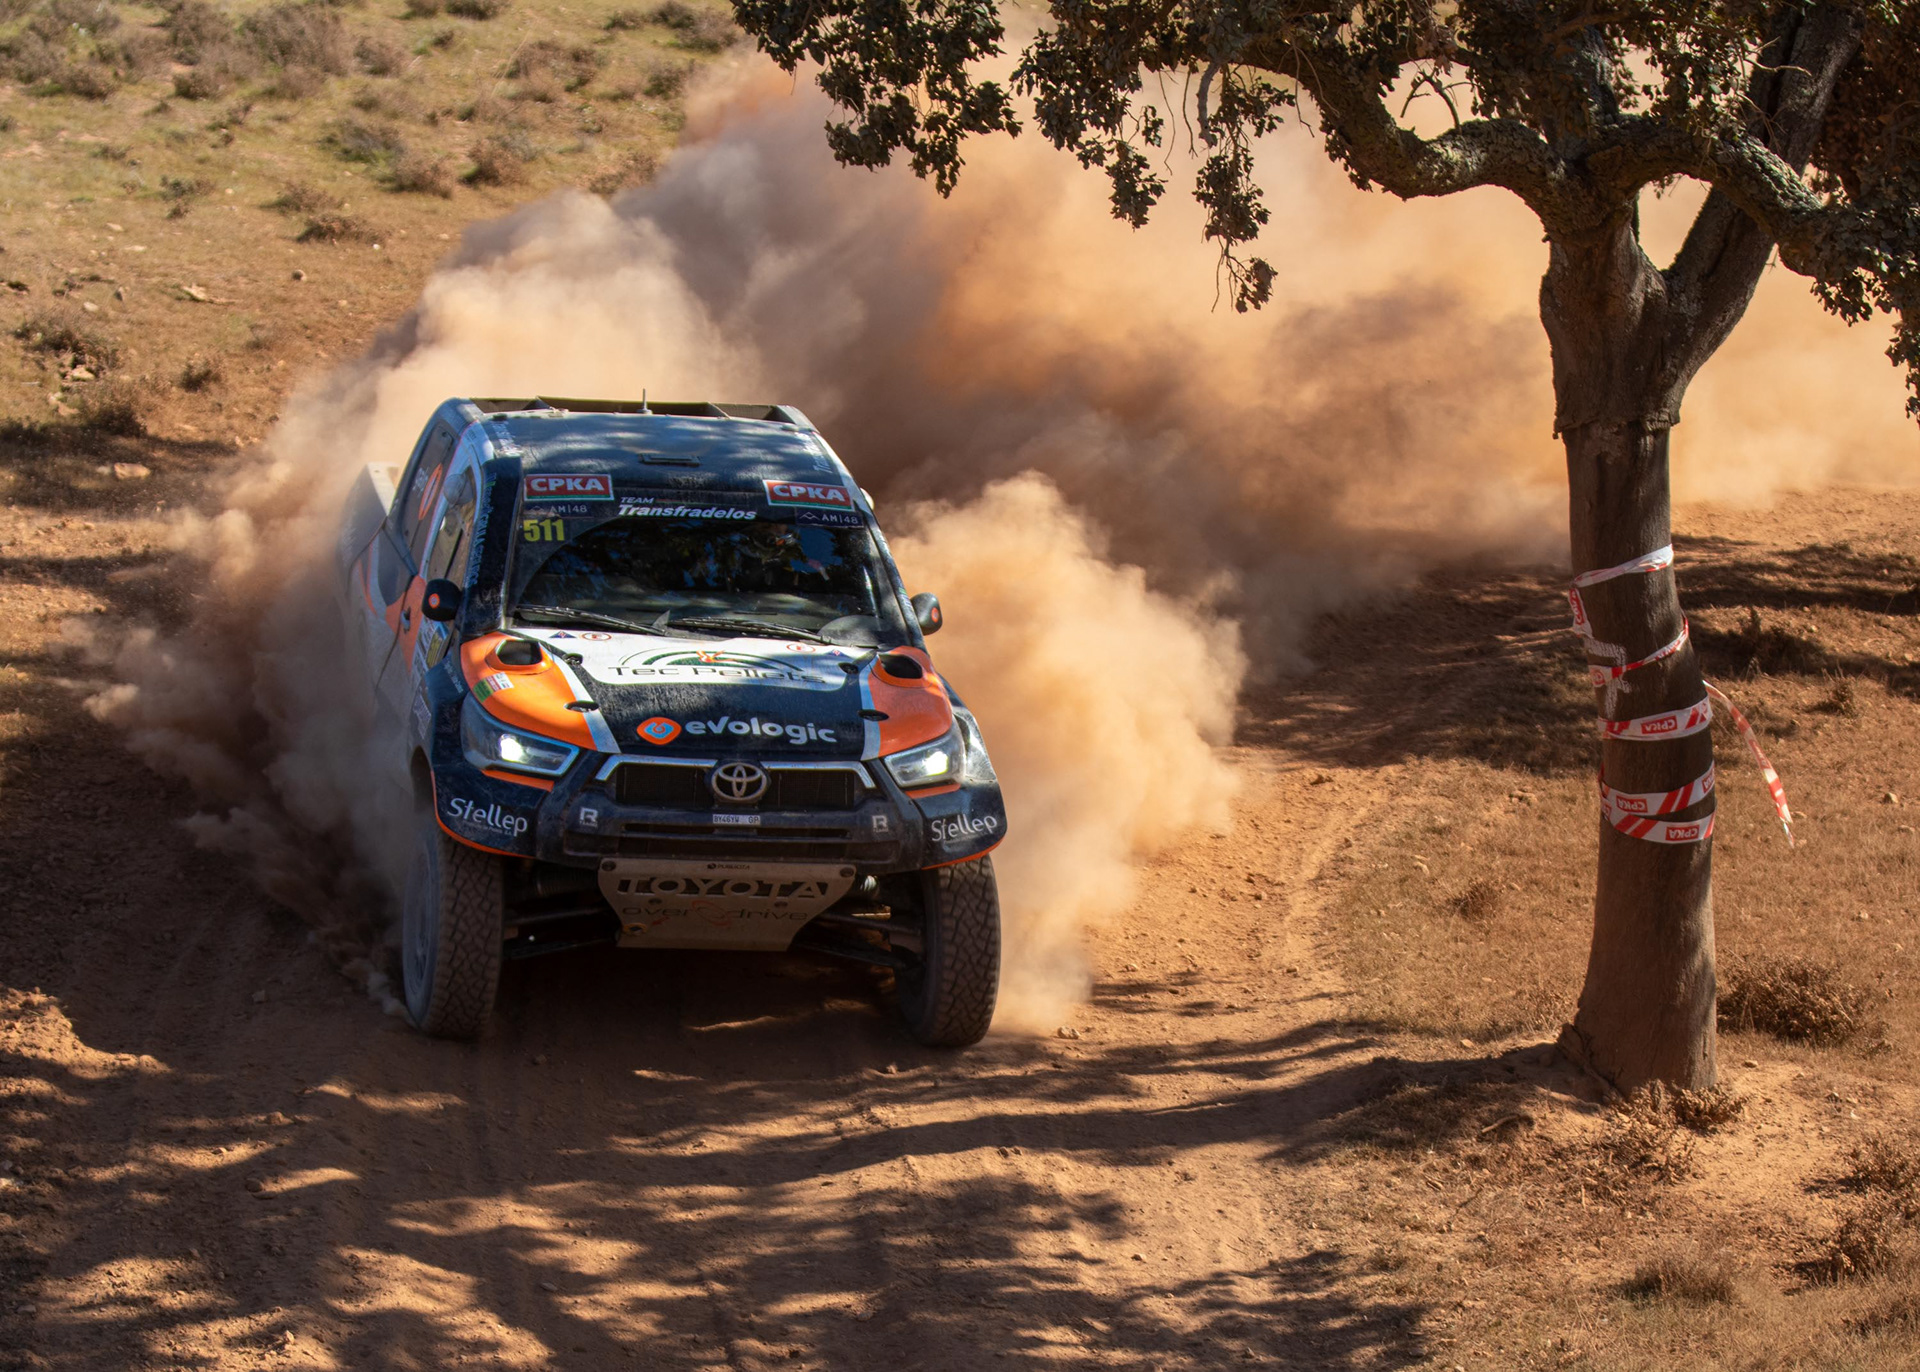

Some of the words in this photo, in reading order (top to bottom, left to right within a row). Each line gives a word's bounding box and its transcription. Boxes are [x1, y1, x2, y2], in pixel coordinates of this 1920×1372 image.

[530, 478, 605, 492] CPKA
[772, 484, 846, 502] CPKA
[620, 496, 655, 505] TEAM
[617, 503, 758, 521] Transfradelos
[523, 518, 565, 543] 511
[607, 665, 680, 678] Tec
[693, 665, 826, 684] Pellets
[685, 715, 837, 745] evologic
[1644, 718, 1676, 731] CPKA
[1617, 800, 1646, 811] CPKA
[446, 797, 528, 837] Stellep
[931, 813, 998, 842] Stellep
[1668, 827, 1698, 839] CPKA
[617, 876, 830, 899] TOYOTA
